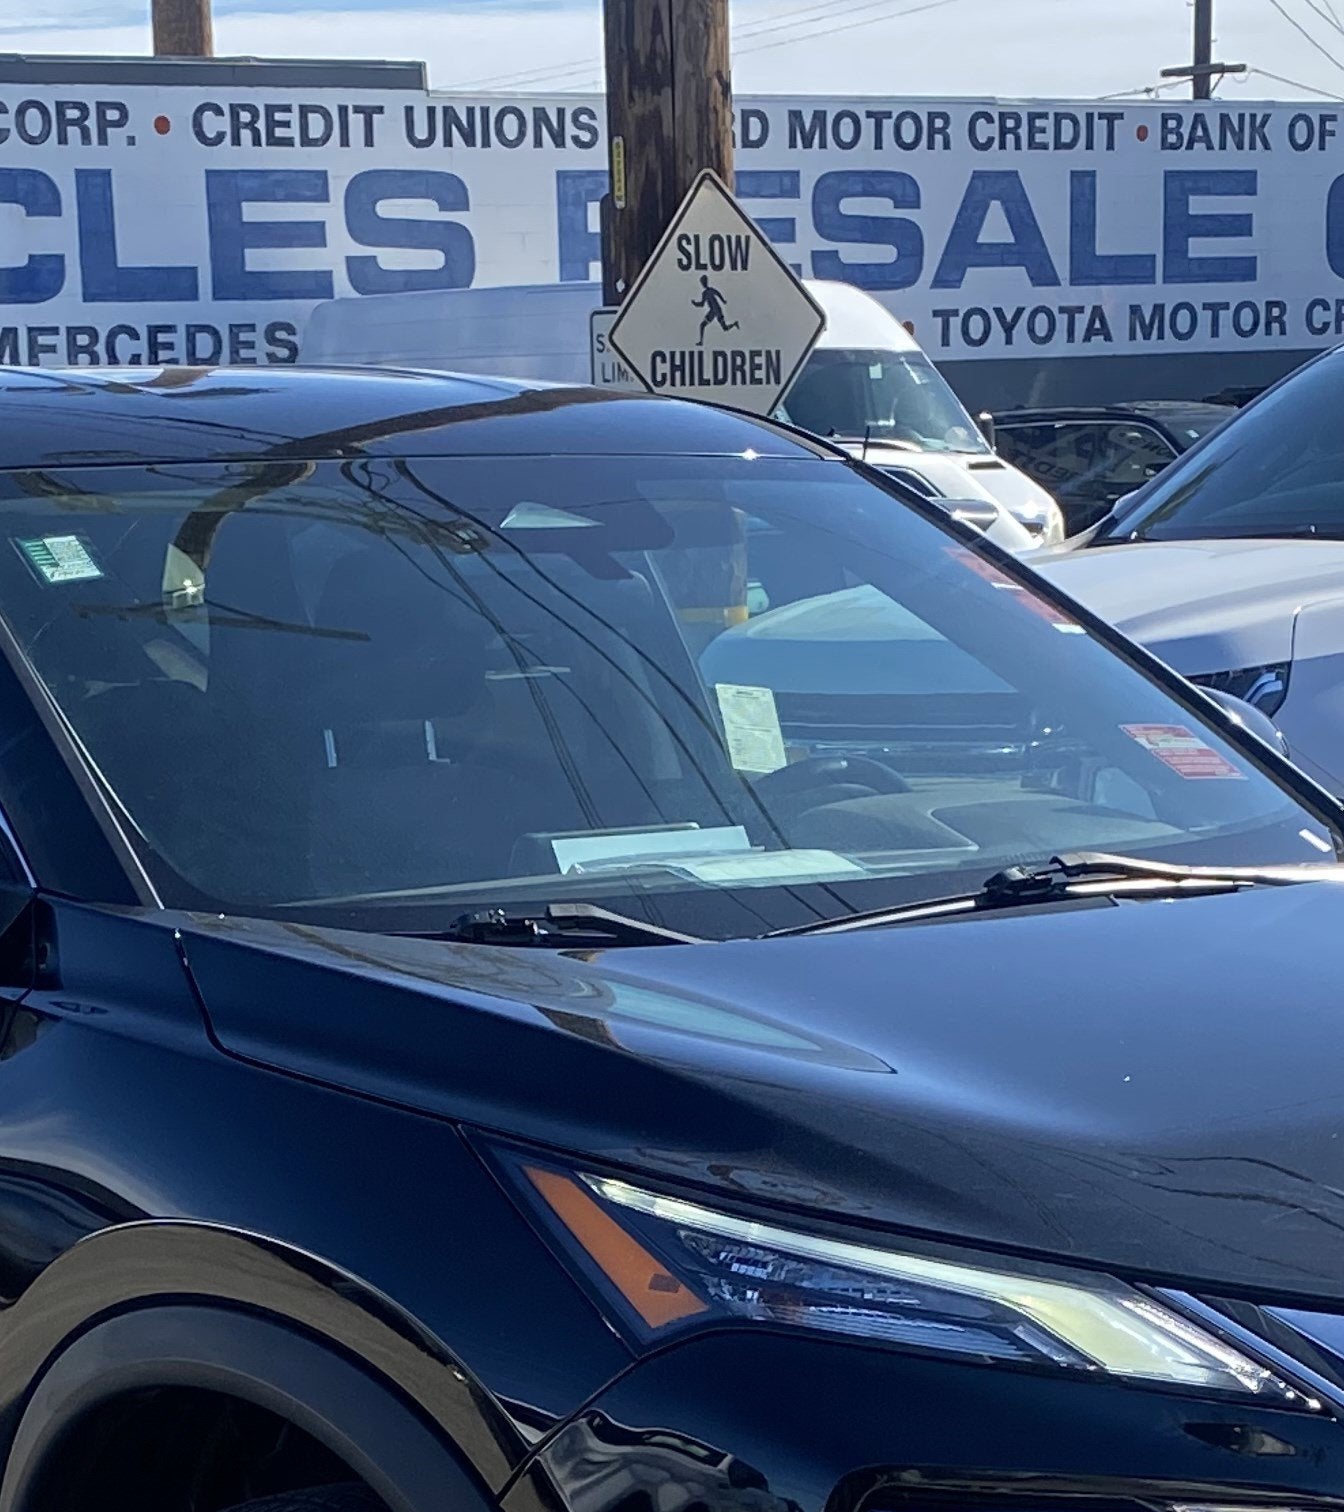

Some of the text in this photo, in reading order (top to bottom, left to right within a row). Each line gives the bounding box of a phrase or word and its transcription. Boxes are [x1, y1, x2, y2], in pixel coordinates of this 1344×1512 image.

[192, 102, 384, 147] CREDIT
[405, 105, 599, 150] UNIONS
[788, 110, 951, 151] MOTOR
[967, 111, 1125, 152] CREDIT
[1160, 112, 1271, 151] BANK
[1287, 112, 1338, 151] OF
[676, 233, 751, 272] SLOW
[932, 305, 1114, 348] TOYOTA
[1128, 300, 1287, 342] MOTOR
[601, 361, 635, 383] LIM
[650, 349, 782, 388] CHILDREN
